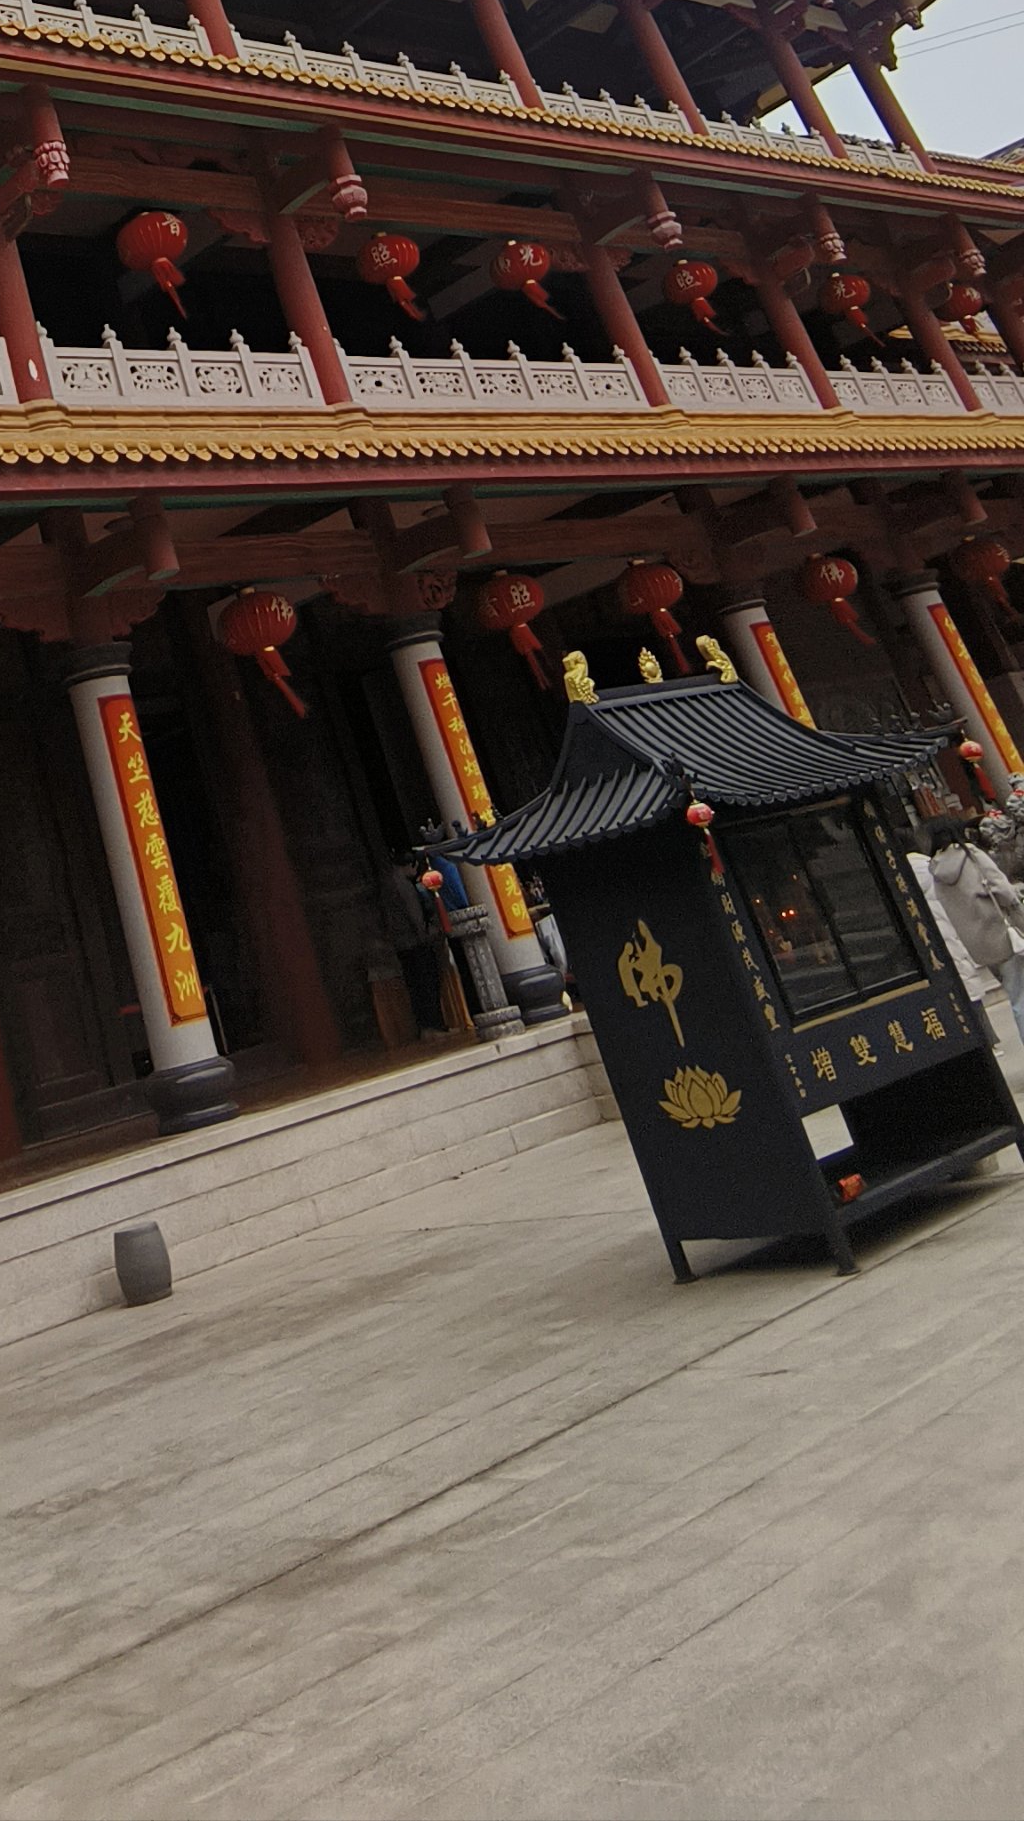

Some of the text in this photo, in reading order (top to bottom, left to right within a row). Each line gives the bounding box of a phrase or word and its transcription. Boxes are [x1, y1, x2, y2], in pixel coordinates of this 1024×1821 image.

[371, 242, 398, 270] 照
[519, 244, 543, 267] 光
[820, 562, 845, 585] 佛
[509, 581, 536, 613] 照
